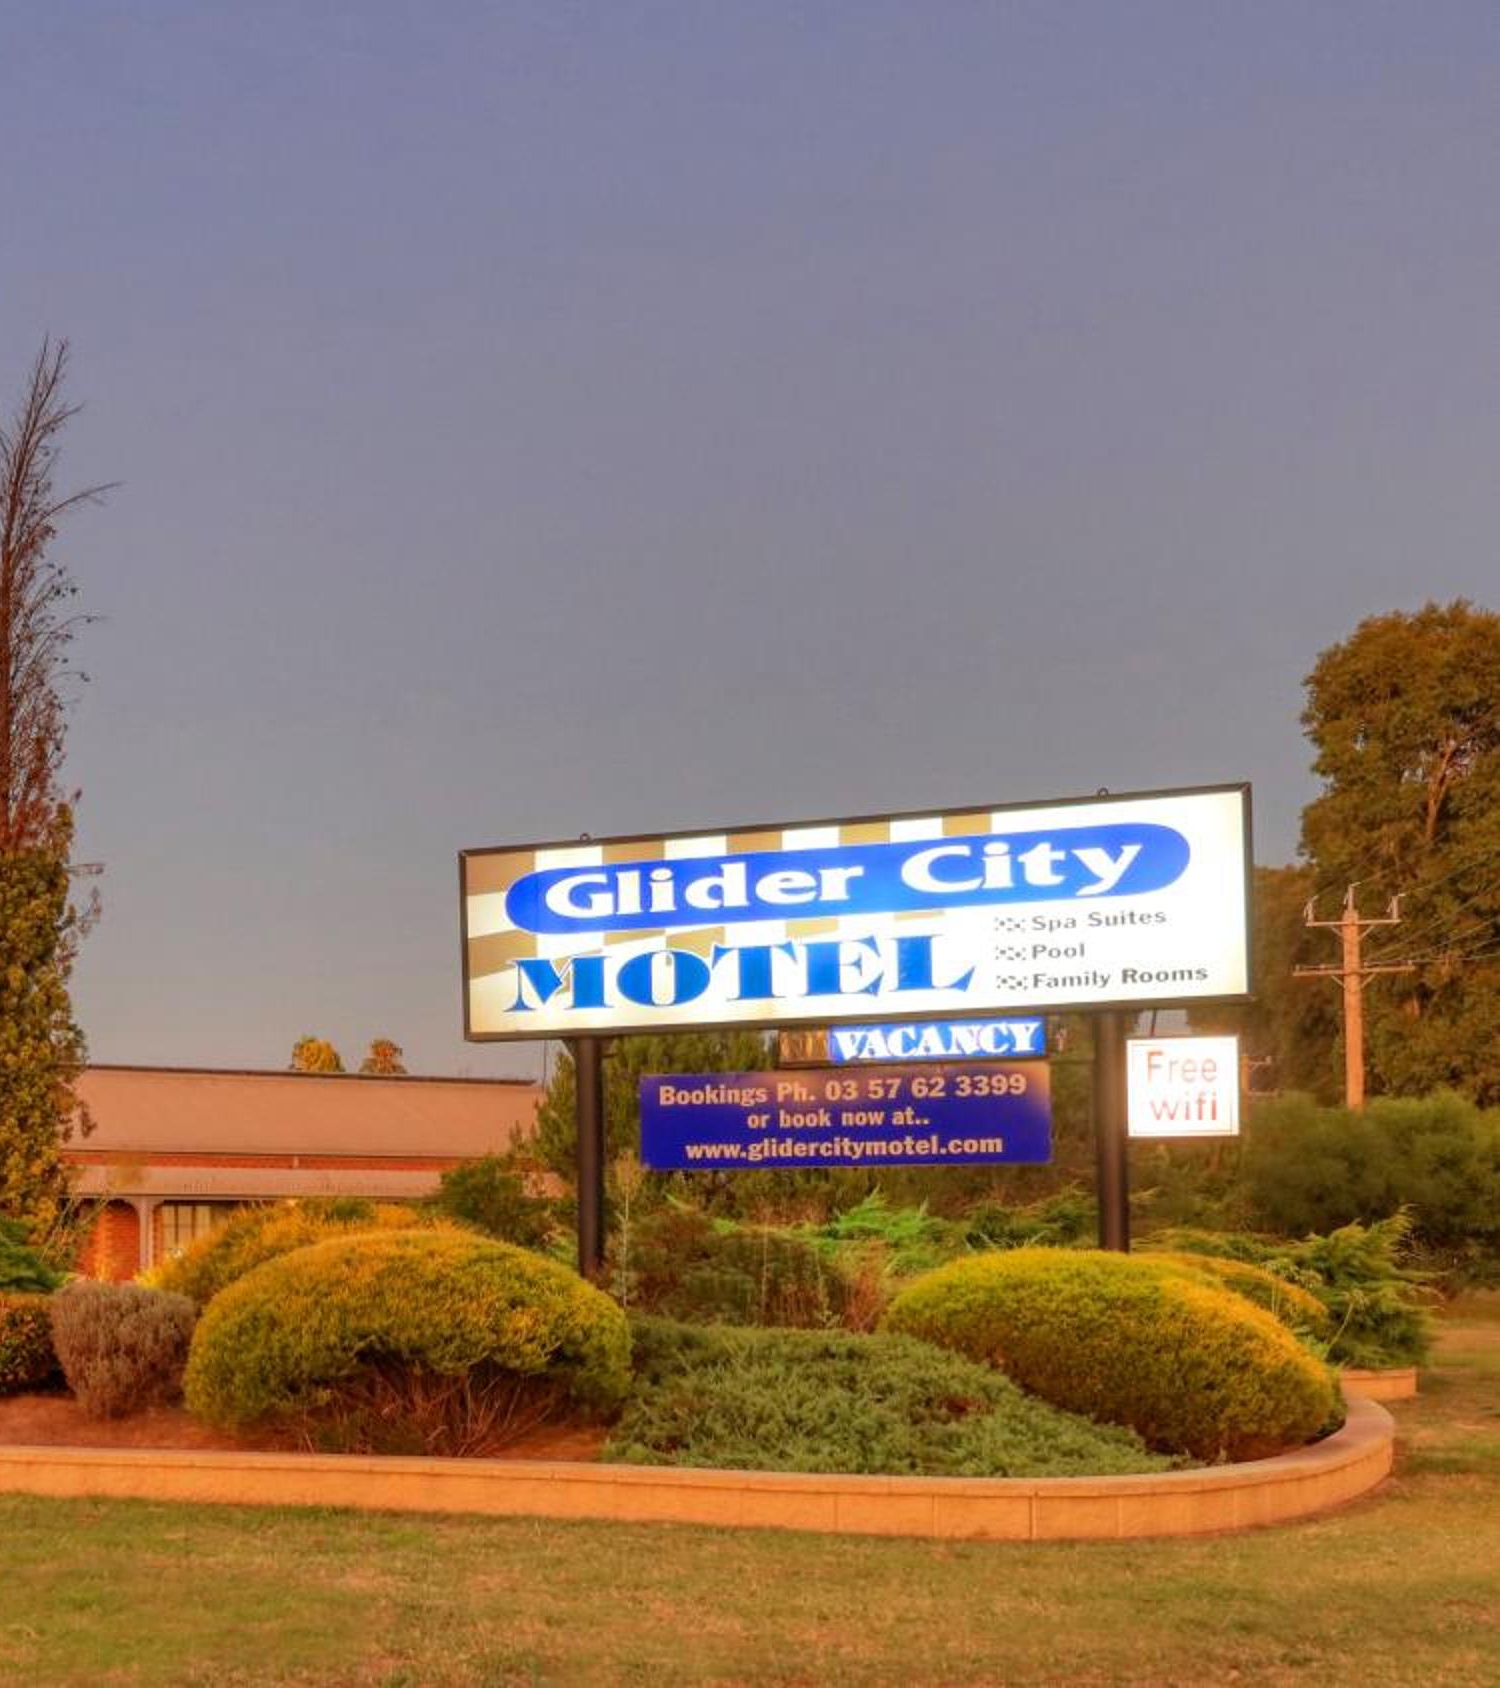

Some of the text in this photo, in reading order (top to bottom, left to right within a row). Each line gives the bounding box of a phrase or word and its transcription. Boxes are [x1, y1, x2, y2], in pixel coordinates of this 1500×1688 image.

[546, 841, 1143, 918] Glider City
[1031, 910, 1167, 932] Spa Suites
[1031, 943, 1085, 960] Pool
[503, 934, 976, 1012] MOTEL
[1033, 967, 1209, 989] Family Rooms
[833, 1022, 1043, 1061] VACANCY
[1148, 1050, 1218, 1082] Free
[659, 1073, 1028, 1107] Bookings Ph. 03 57 62 3399
[747, 1113, 769, 1129] or
[779, 1109, 831, 1128] book
[841, 1110, 884, 1126] now
[1149, 1091, 1218, 1121] wifi
[685, 1134, 1003, 1161] www.glidercitymotel.com
